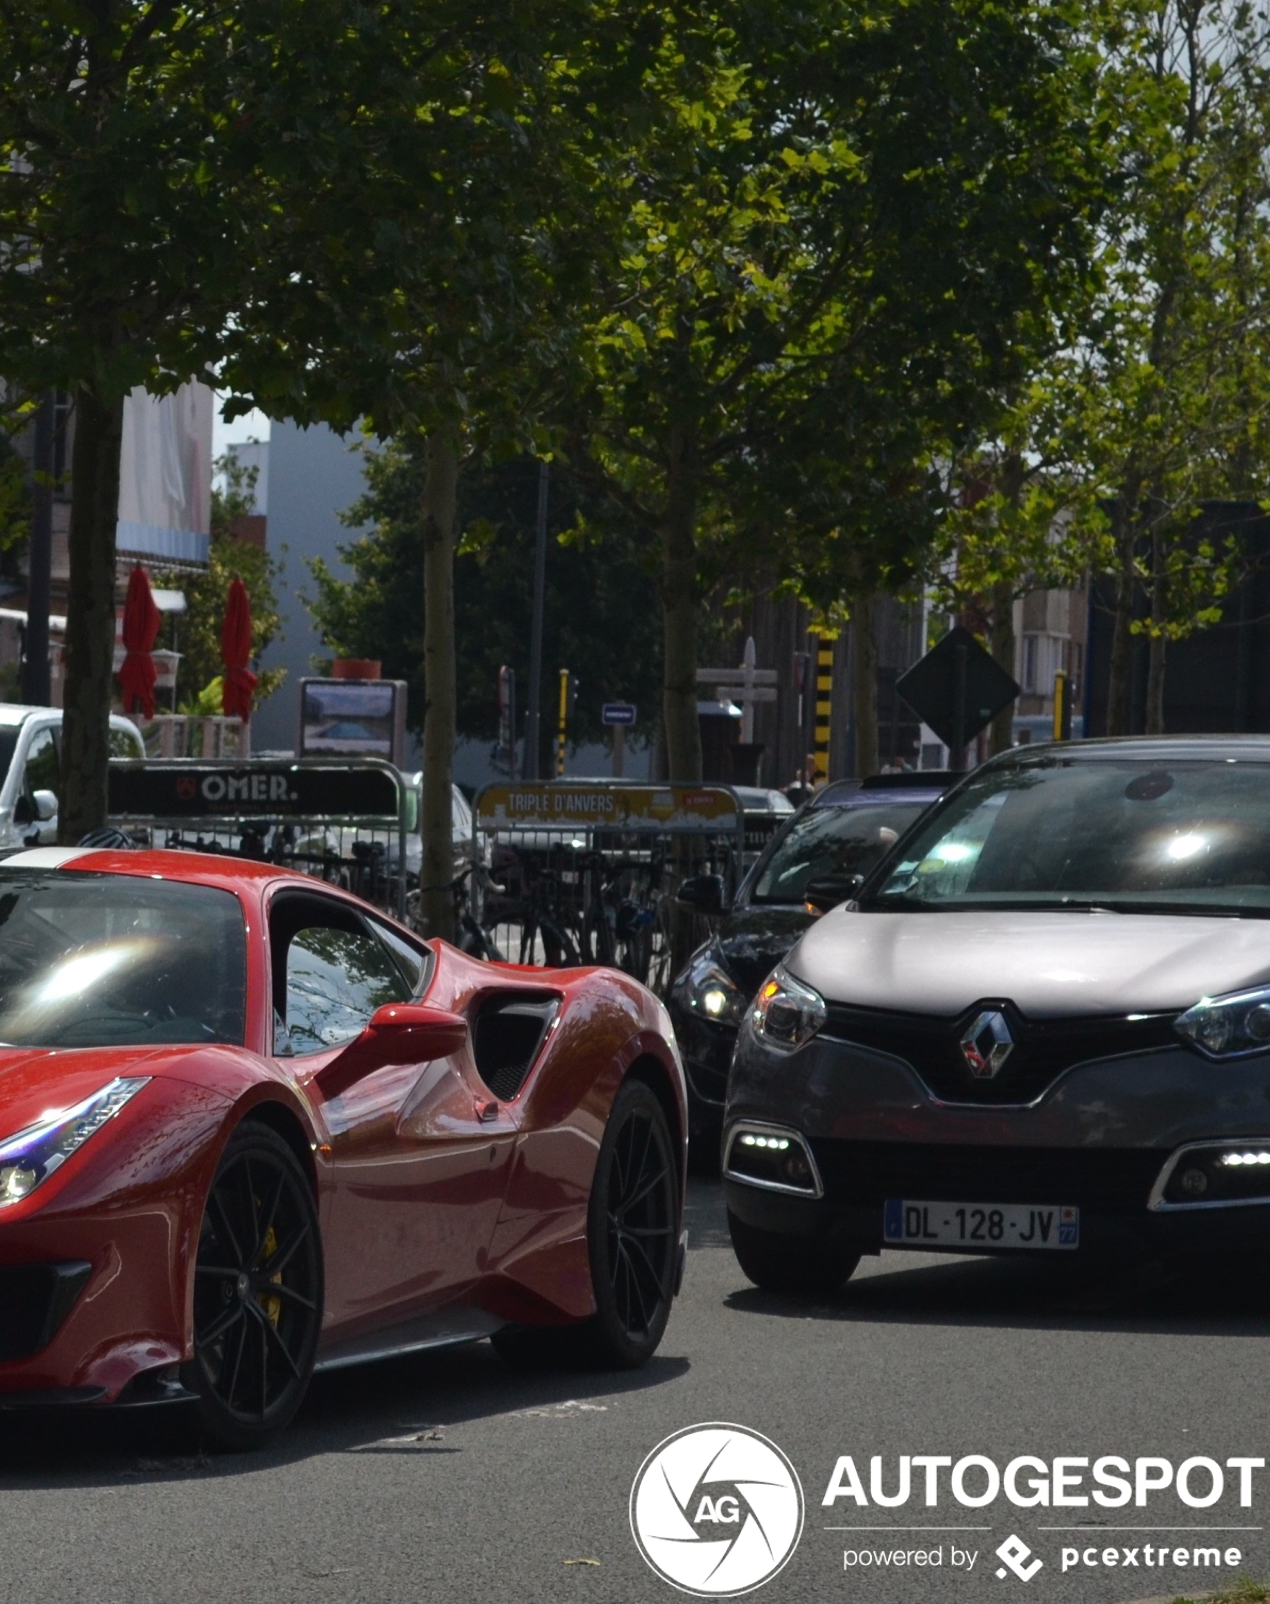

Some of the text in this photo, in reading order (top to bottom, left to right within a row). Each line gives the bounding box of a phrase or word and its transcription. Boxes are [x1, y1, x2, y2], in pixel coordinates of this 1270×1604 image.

[509, 793, 614, 814] TRIPLE D'ANVERS
[1061, 1226, 1076, 1242] 77
